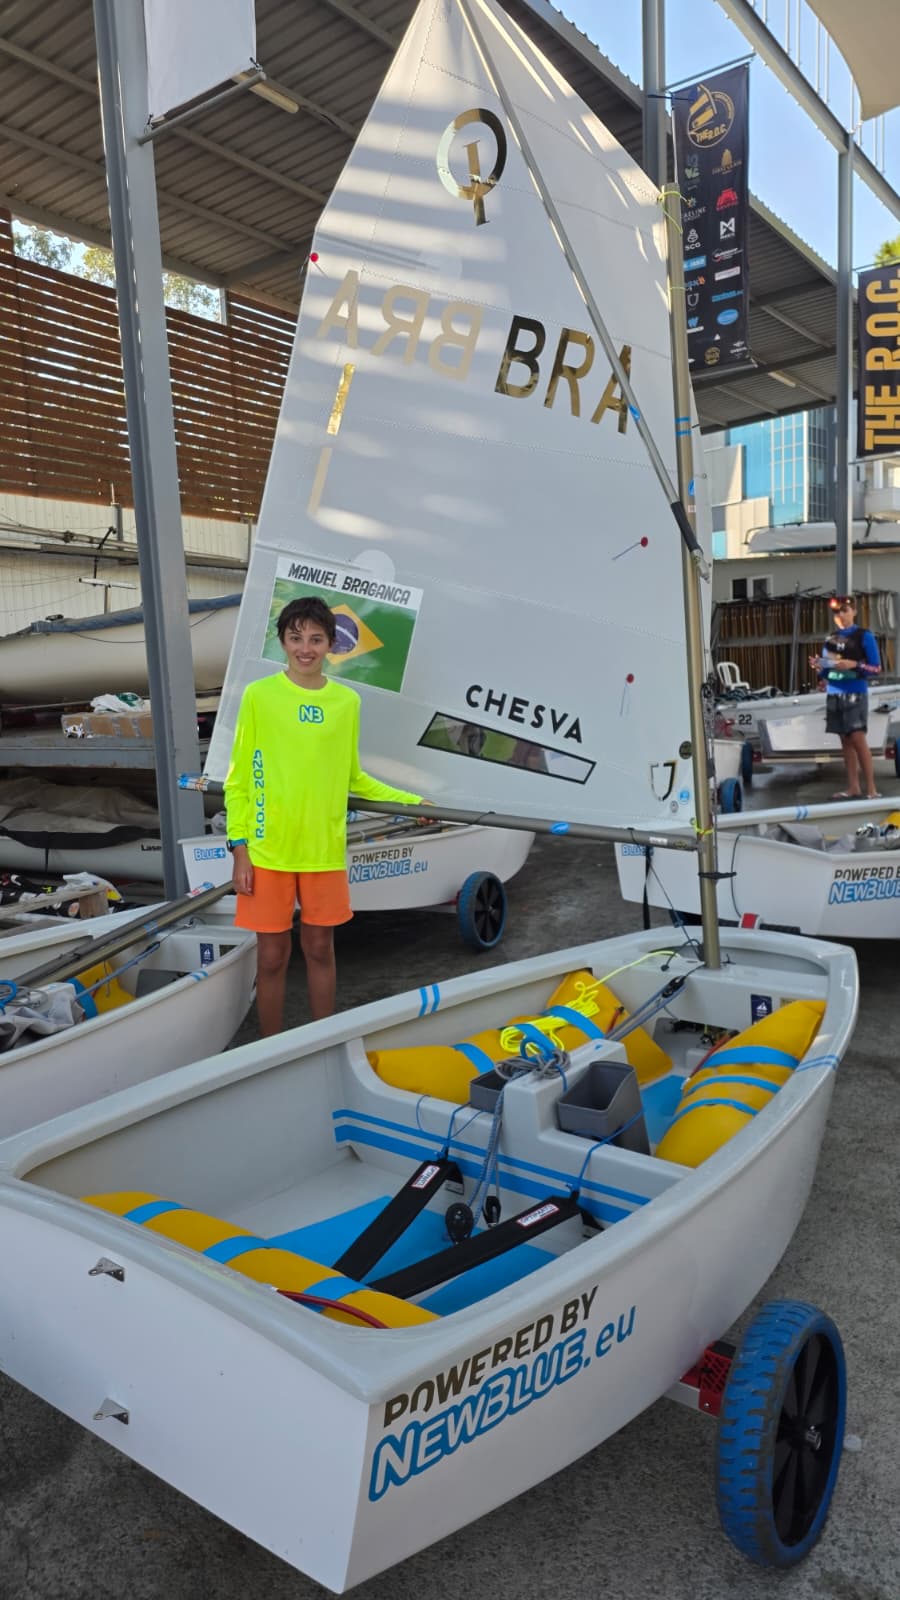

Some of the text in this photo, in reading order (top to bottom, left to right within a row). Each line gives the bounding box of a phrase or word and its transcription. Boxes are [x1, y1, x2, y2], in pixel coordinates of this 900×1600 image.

[494, 314, 632, 434] BRA
[864, 385, 900, 451] THE
[288, 562, 411, 605] MANUEL BRAGANCA
[299, 704, 324, 724] NB
[466, 684, 582, 744] CHESVA
[738, 714, 752, 725] 22
[252, 749, 265, 839] R.O.C. 2025
[141, 843, 161, 851] Lase
[352, 846, 414, 864] POWERED BY
[834, 866, 894, 881] POWERED
[383, 1285, 599, 1428] POWERED BY
